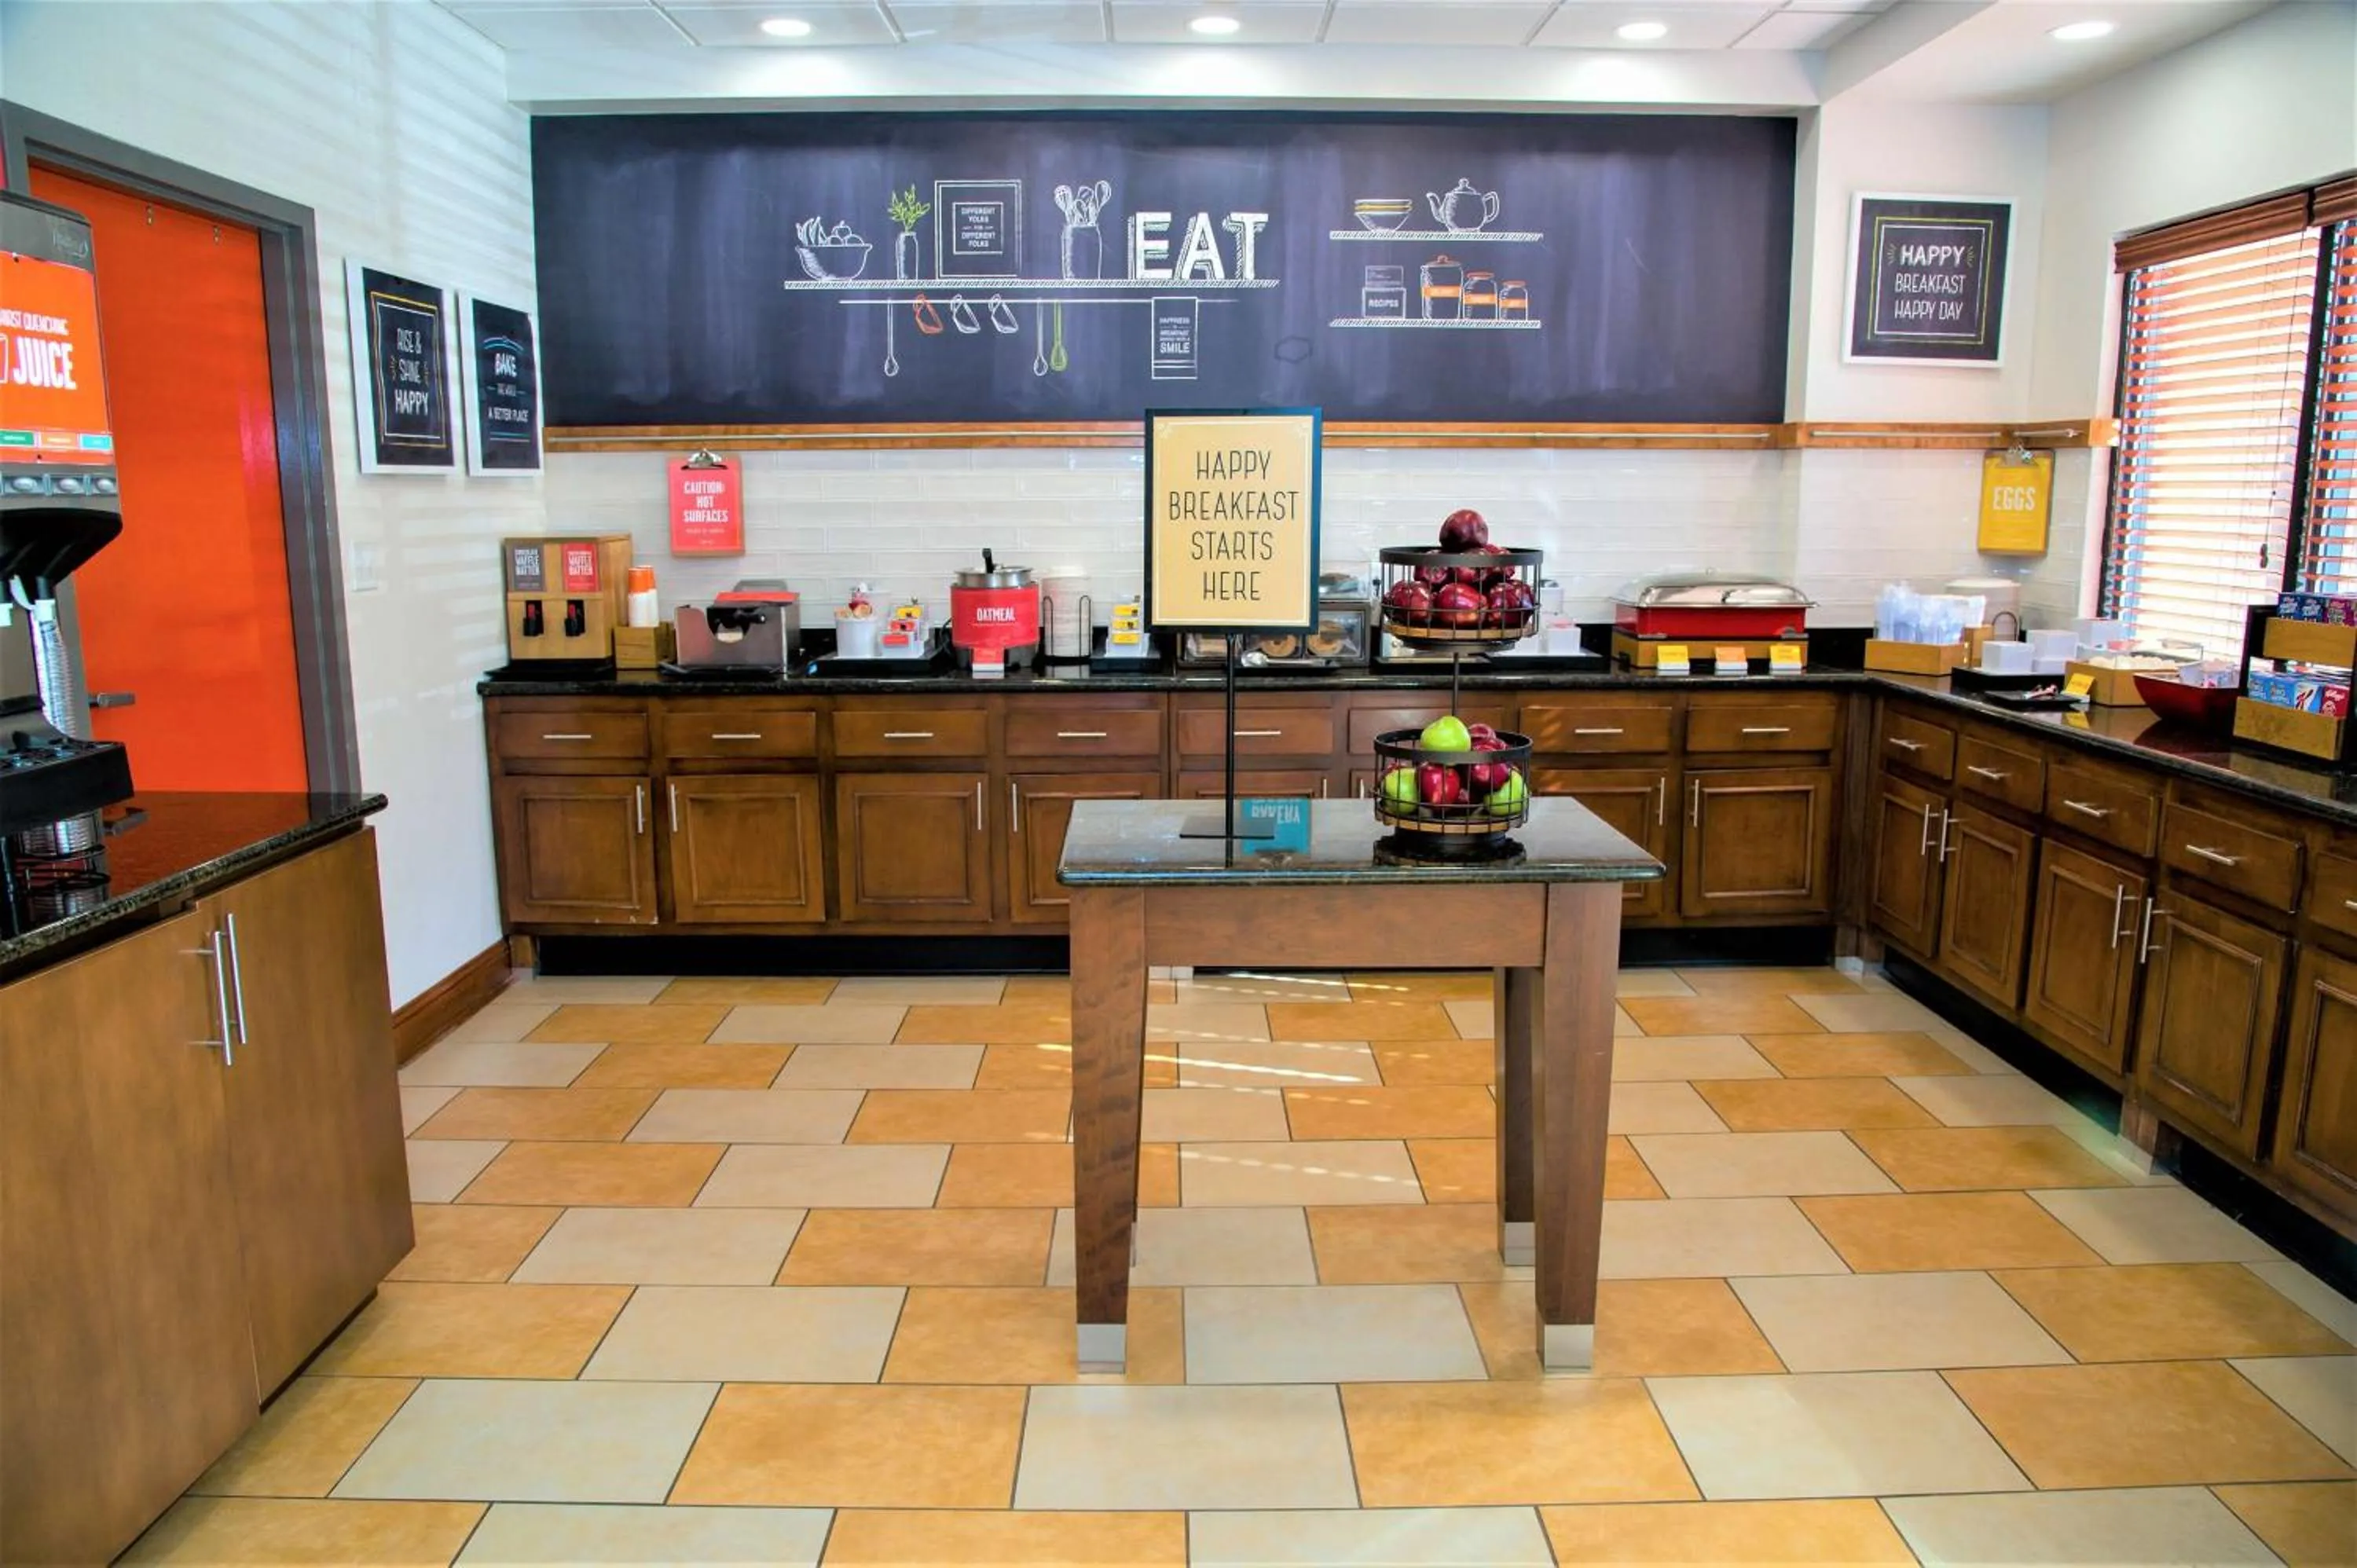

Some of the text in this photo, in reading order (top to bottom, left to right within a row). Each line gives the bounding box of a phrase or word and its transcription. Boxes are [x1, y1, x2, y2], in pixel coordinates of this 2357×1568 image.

[1128, 211, 1269, 280] EAT
[1900, 244, 1965, 266] HAPPY
[1894, 273, 1967, 294] BREAKFAST
[1894, 299, 1963, 321] HAPPY DAY
[397, 328, 414, 354] RISE
[1160, 342, 1190, 354] SMILE
[13, 335, 78, 390] JUICE
[394, 389, 429, 416] HAPPY
[1196, 449, 1271, 481] HAPPY
[695, 496, 714, 509] HOT
[1169, 490, 1299, 521] BREAKFAST
[1992, 485, 2036, 511] EGGS
[683, 509, 729, 523] SURFACES
[1191, 530, 1274, 560] STARTS
[1202, 571, 1261, 601] HERE
[977, 606, 1016, 621] OATMEAL
